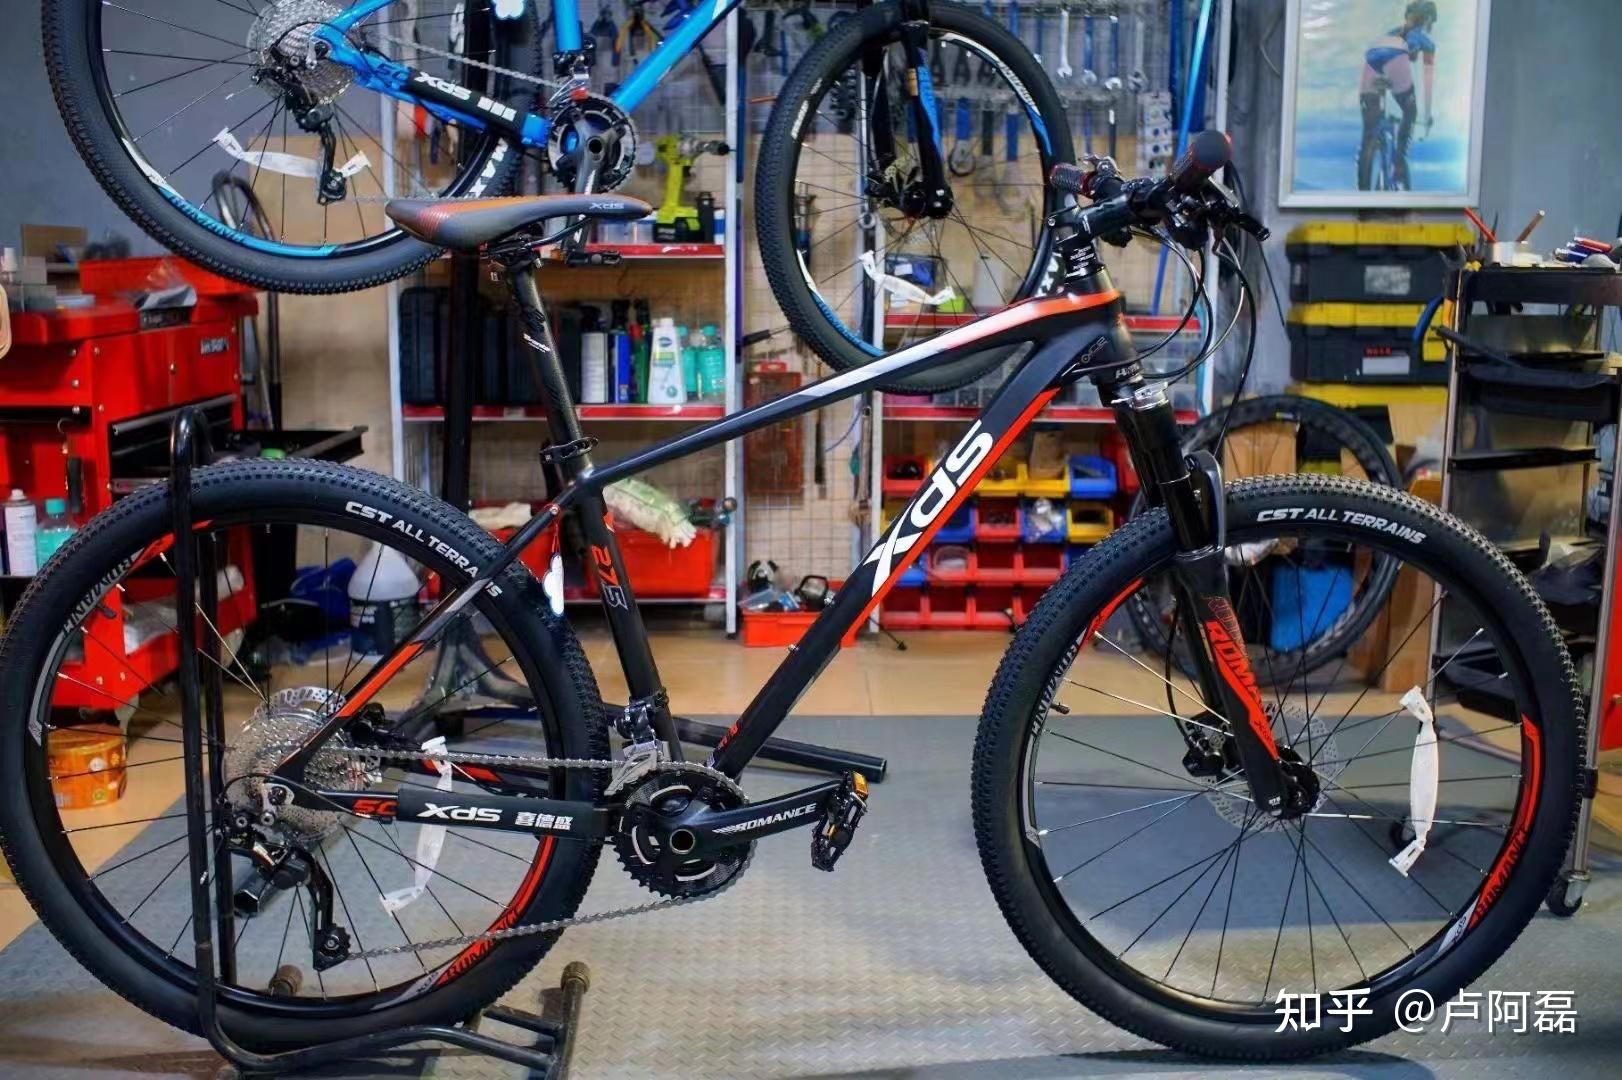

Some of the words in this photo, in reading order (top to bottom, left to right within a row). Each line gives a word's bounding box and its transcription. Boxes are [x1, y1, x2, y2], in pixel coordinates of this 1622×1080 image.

[1256, 507, 1305, 522] CST
[1304, 508, 1338, 521] ALL
[1342, 510, 1427, 545] TERRAINS
[345, 501, 393, 525] CST
[392, 519, 424, 543] ALL
[427, 535, 503, 598] TERRAS
[733, 803, 818, 833] ROMANCE
